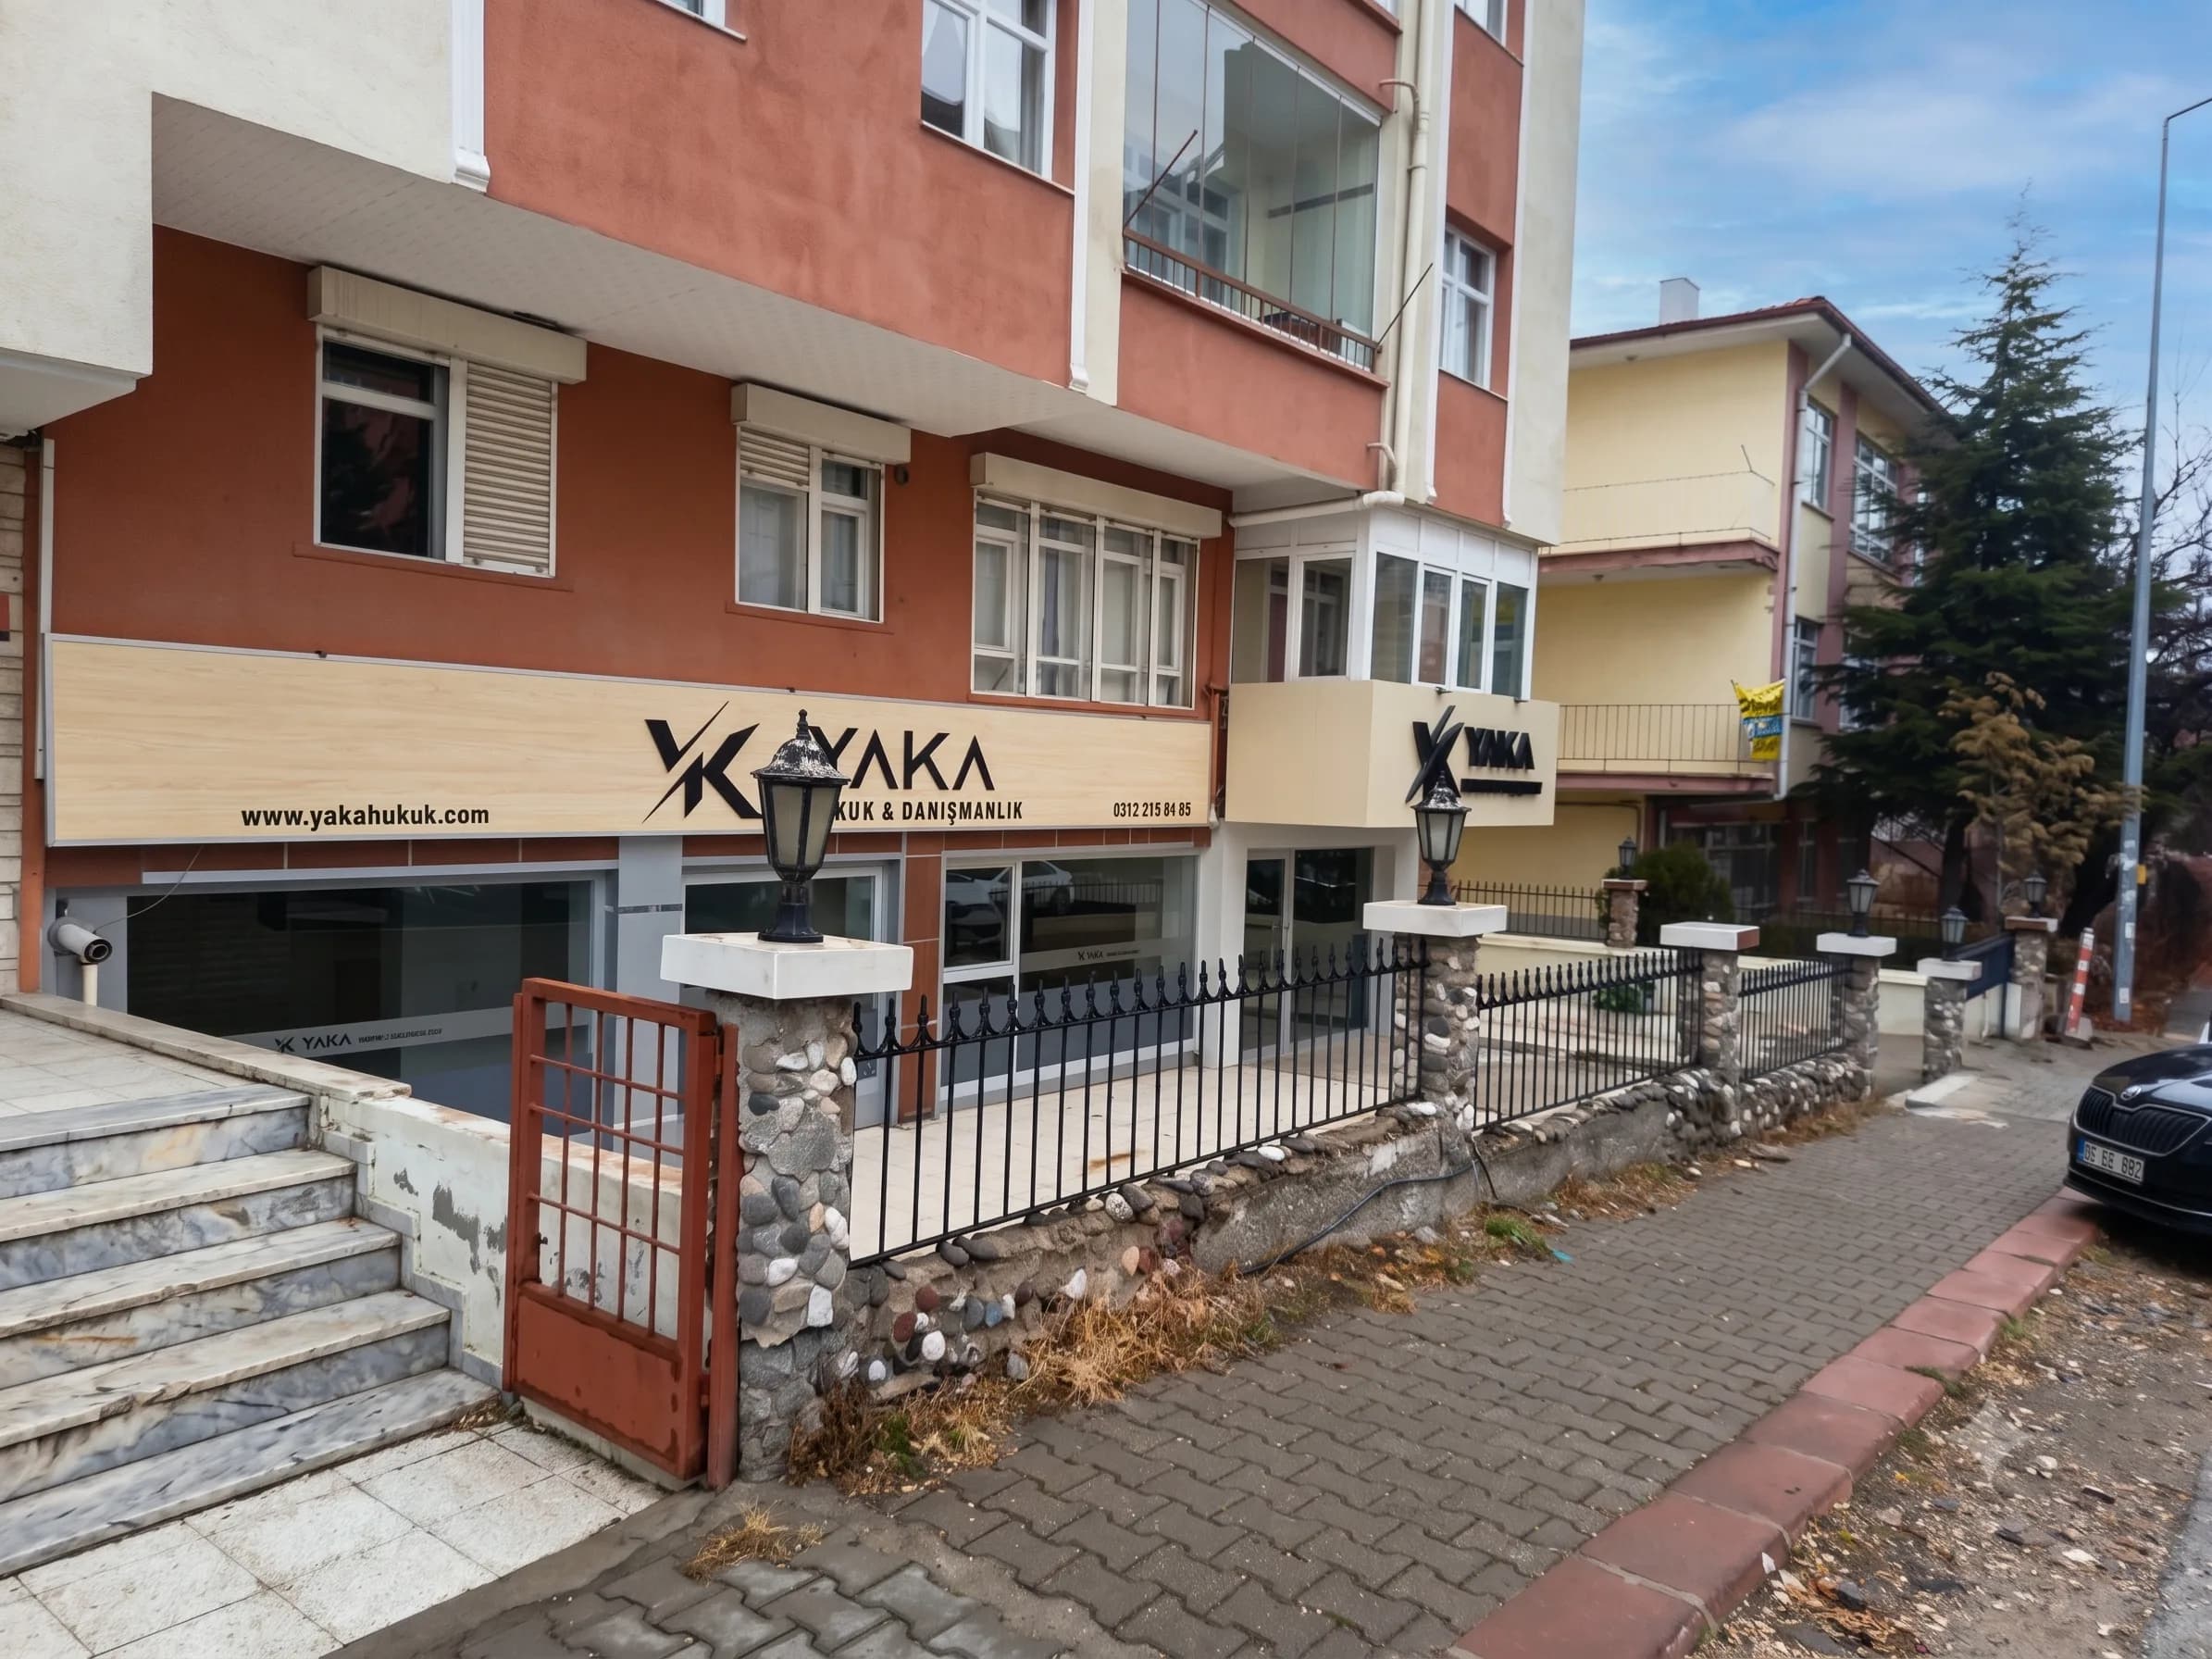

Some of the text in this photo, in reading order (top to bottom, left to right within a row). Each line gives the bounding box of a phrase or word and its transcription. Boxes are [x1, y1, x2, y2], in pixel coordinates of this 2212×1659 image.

[809, 725, 995, 792] YAKA
[241, 804, 490, 831] www.yakahukuk.com
[834, 801, 1023, 825] KUK & DANIŞMANLIK
[1113, 802, 1191, 817] 0312 215 84 85
[302, 1032, 352, 1050] YAKA
